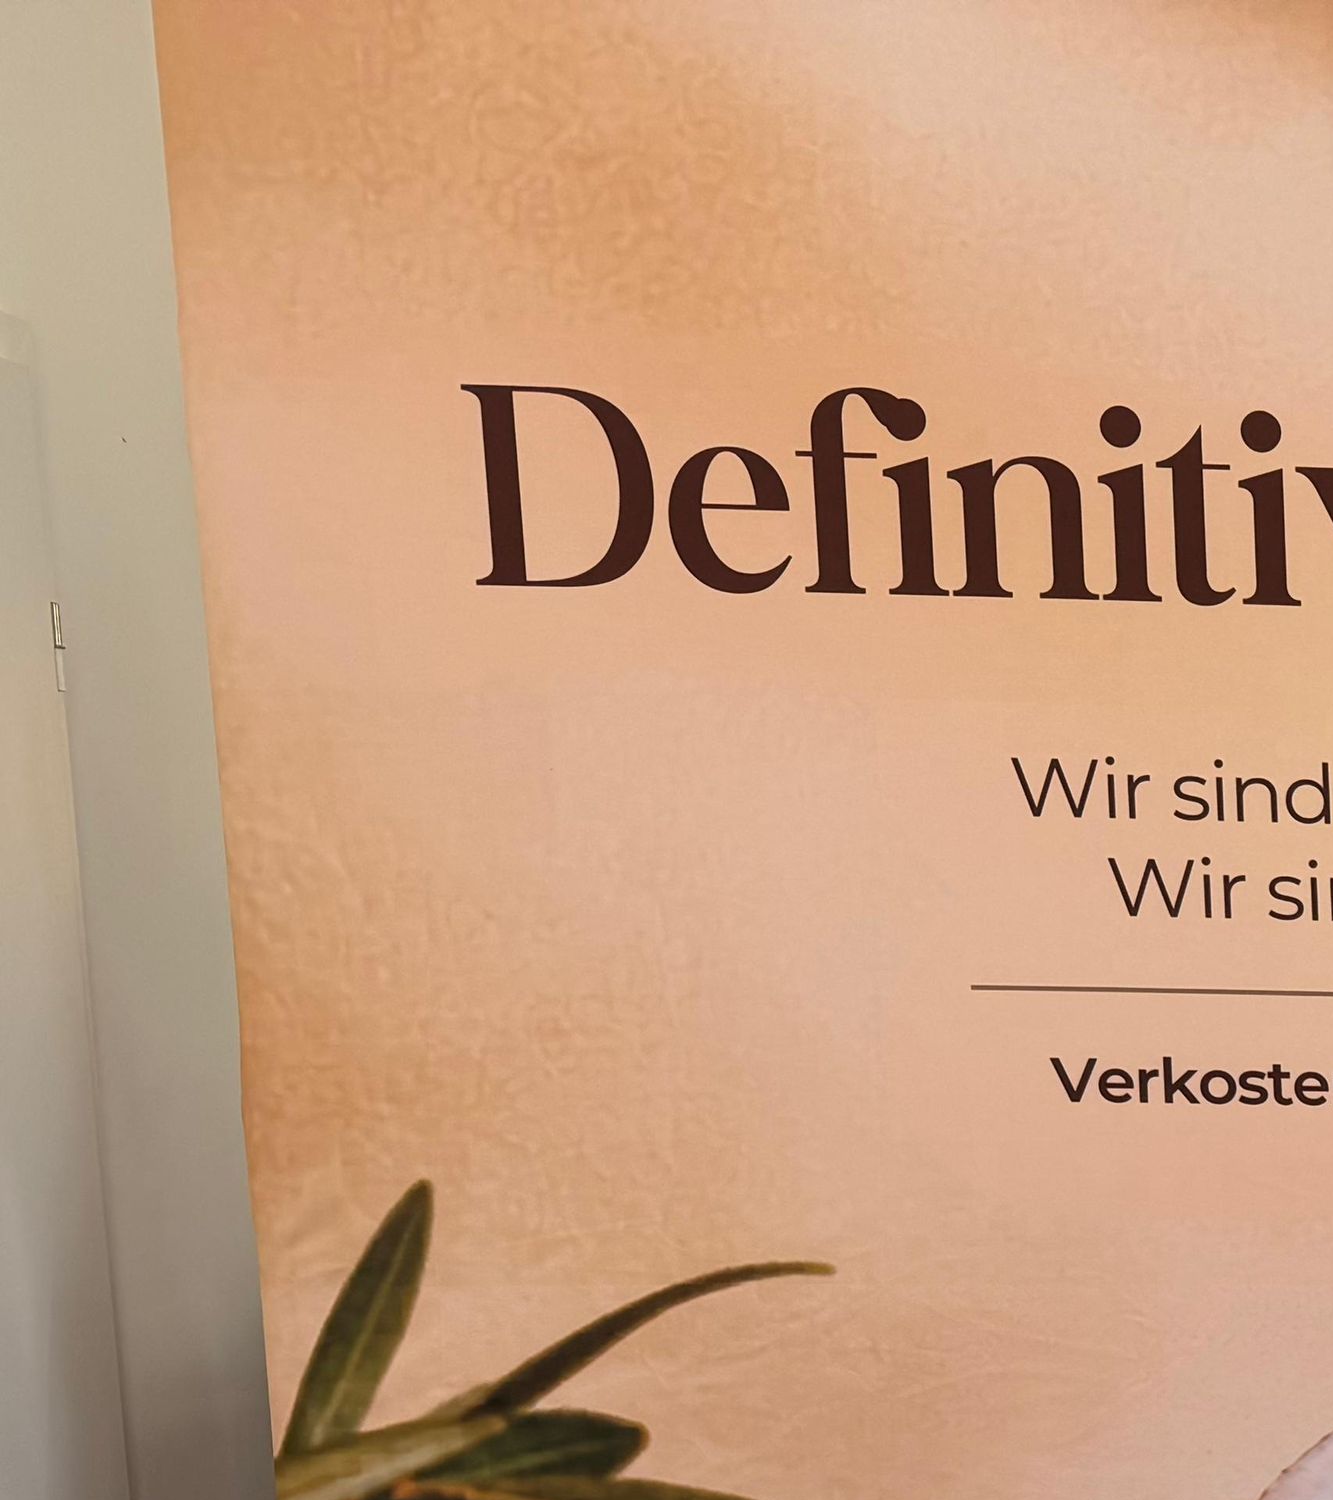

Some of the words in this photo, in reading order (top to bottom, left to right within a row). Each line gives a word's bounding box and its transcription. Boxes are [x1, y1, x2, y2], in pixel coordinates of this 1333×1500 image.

[1011, 756, 1150, 819] Wir
[1173, 759, 1332, 825] sind
[1108, 857, 1246, 919] Wir
